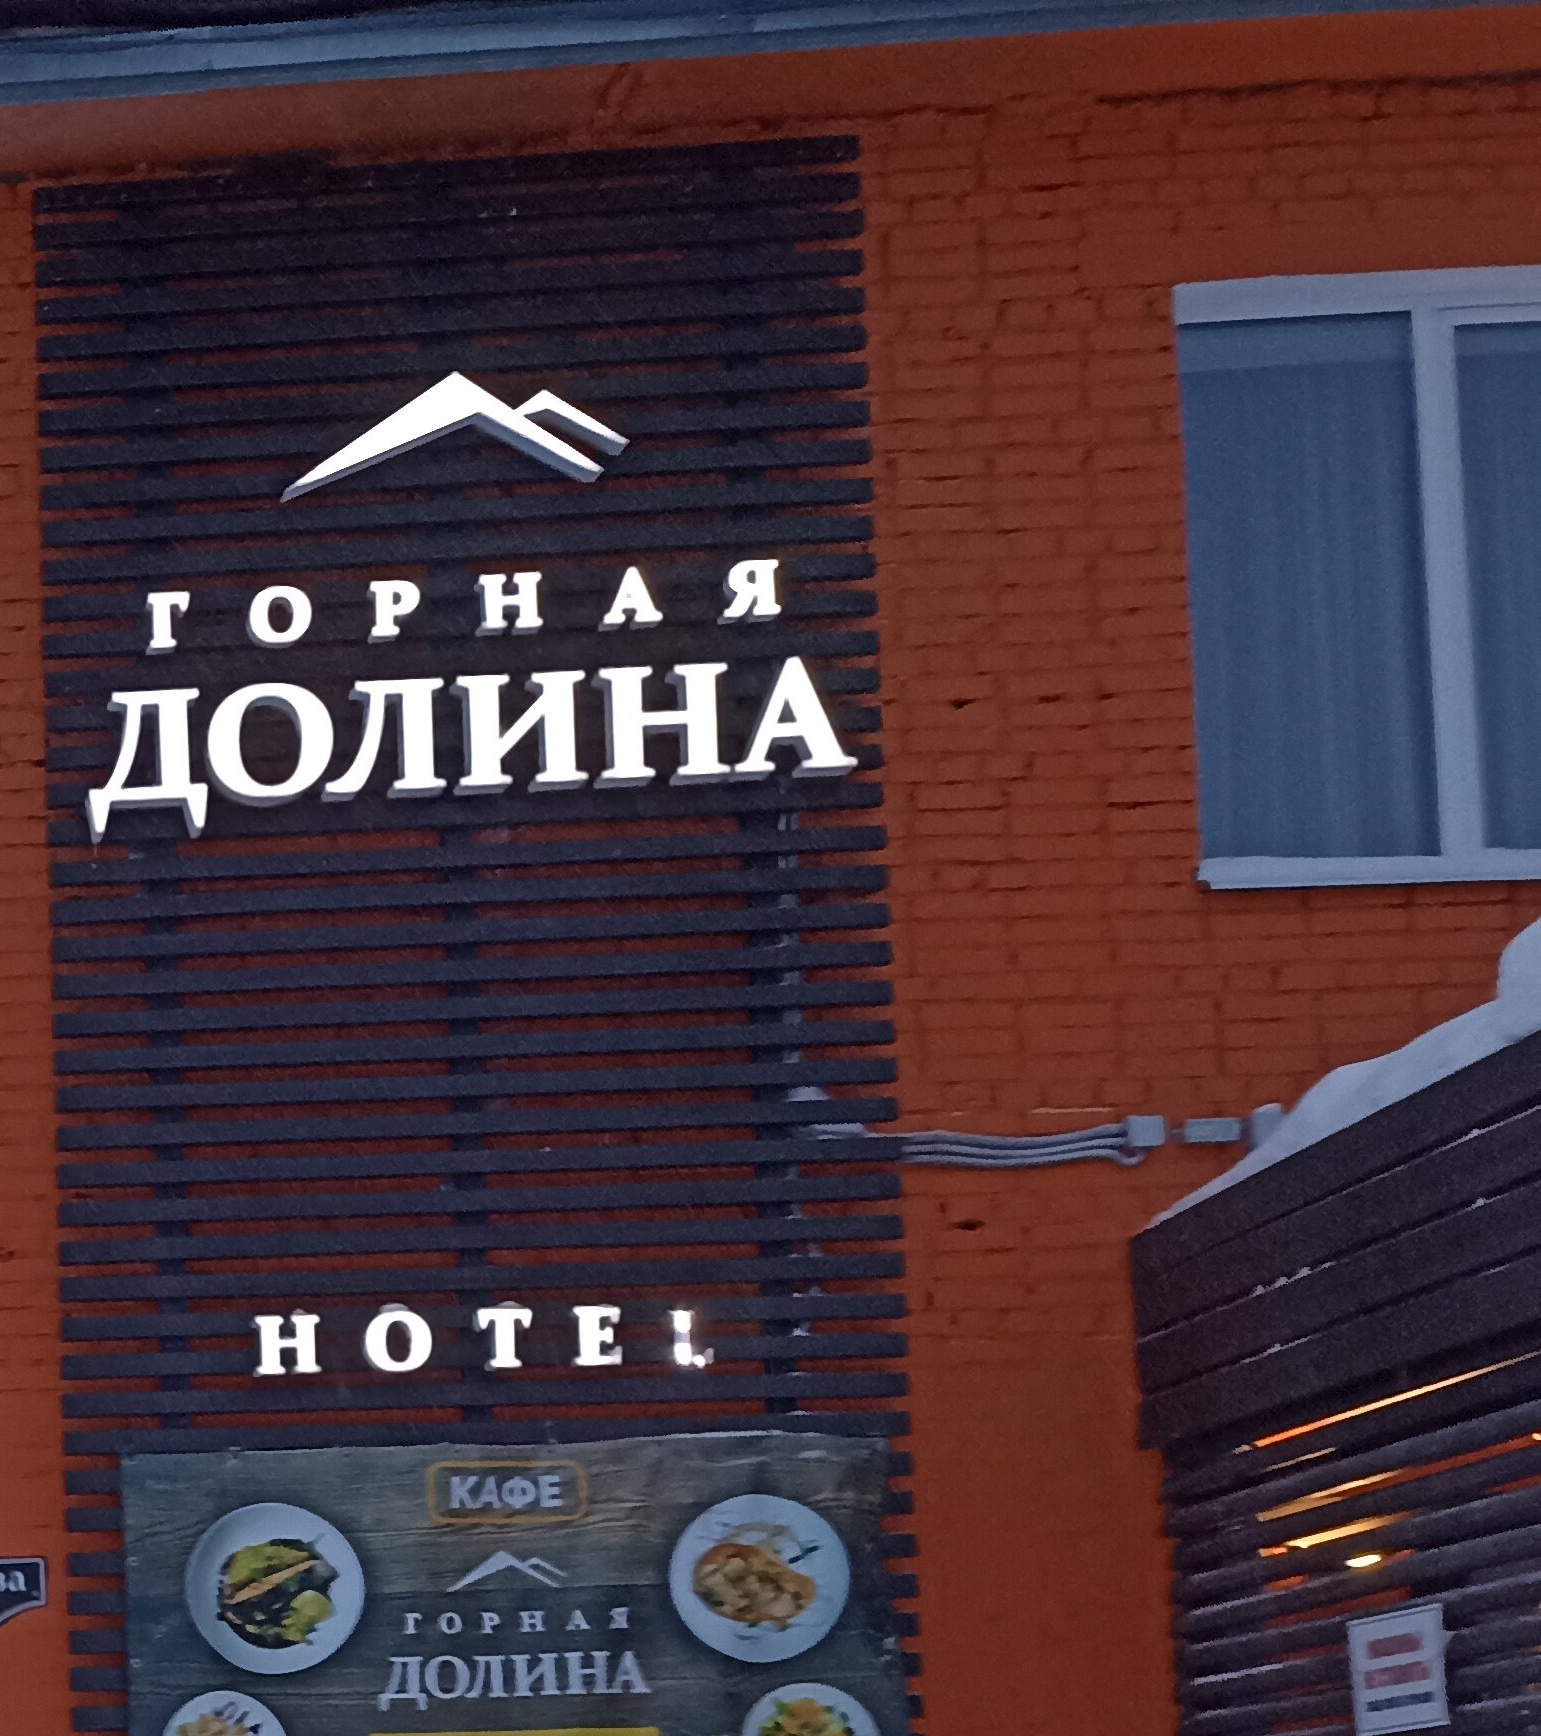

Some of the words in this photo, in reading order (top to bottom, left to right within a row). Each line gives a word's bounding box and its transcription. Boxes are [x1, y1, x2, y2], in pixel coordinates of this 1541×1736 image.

[145, 557, 782, 654] ГОРНАЯ
[85, 655, 858, 845] ДОЛИНА
[251, 1301, 715, 1377] HOTEL
[448, 1474, 564, 1509] КАФЕ
[402, 1606, 630, 1635] ГОРНАЯ
[377, 1650, 652, 1712] ДОЛИНА
